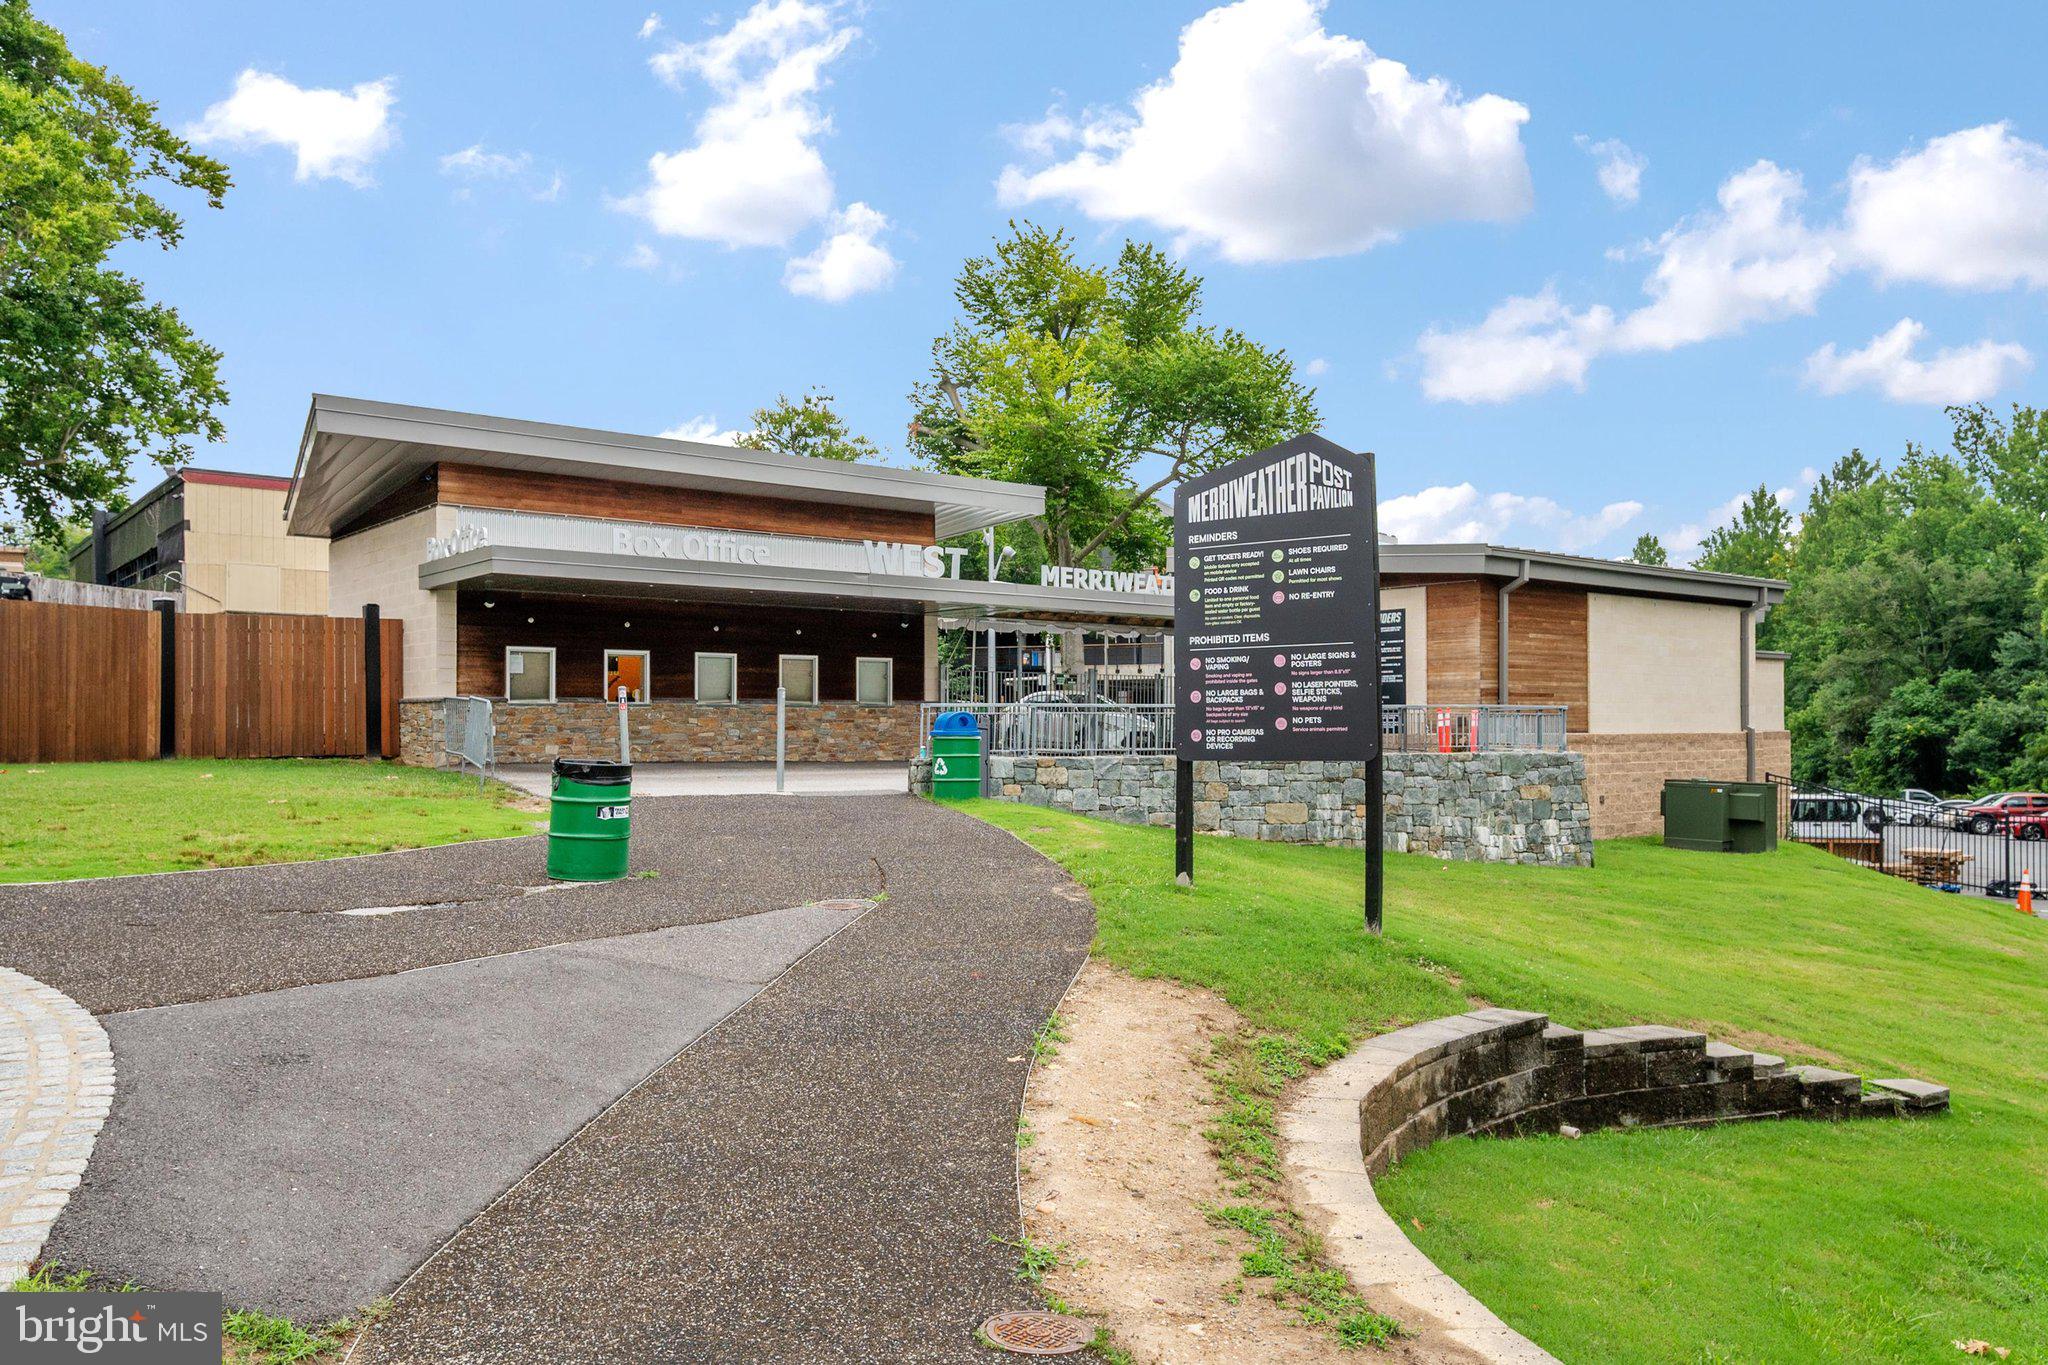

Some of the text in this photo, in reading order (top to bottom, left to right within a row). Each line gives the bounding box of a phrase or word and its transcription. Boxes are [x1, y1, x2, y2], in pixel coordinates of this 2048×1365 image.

[1309, 452, 1352, 490] POST
[1188, 452, 1308, 523] MERRIWEATHER
[1310, 484, 1354, 510] PAVILION
[613, 526, 770, 565] Box Office
[1188, 531, 1238, 544] REMINDERS
[1313, 544, 1348, 552] REQUIRED
[863, 540, 968, 580] WEST
[1301, 591, 1335, 599] RE-ENTRY
[1190, 633, 1270, 644] PROHIBITED ITEMS
